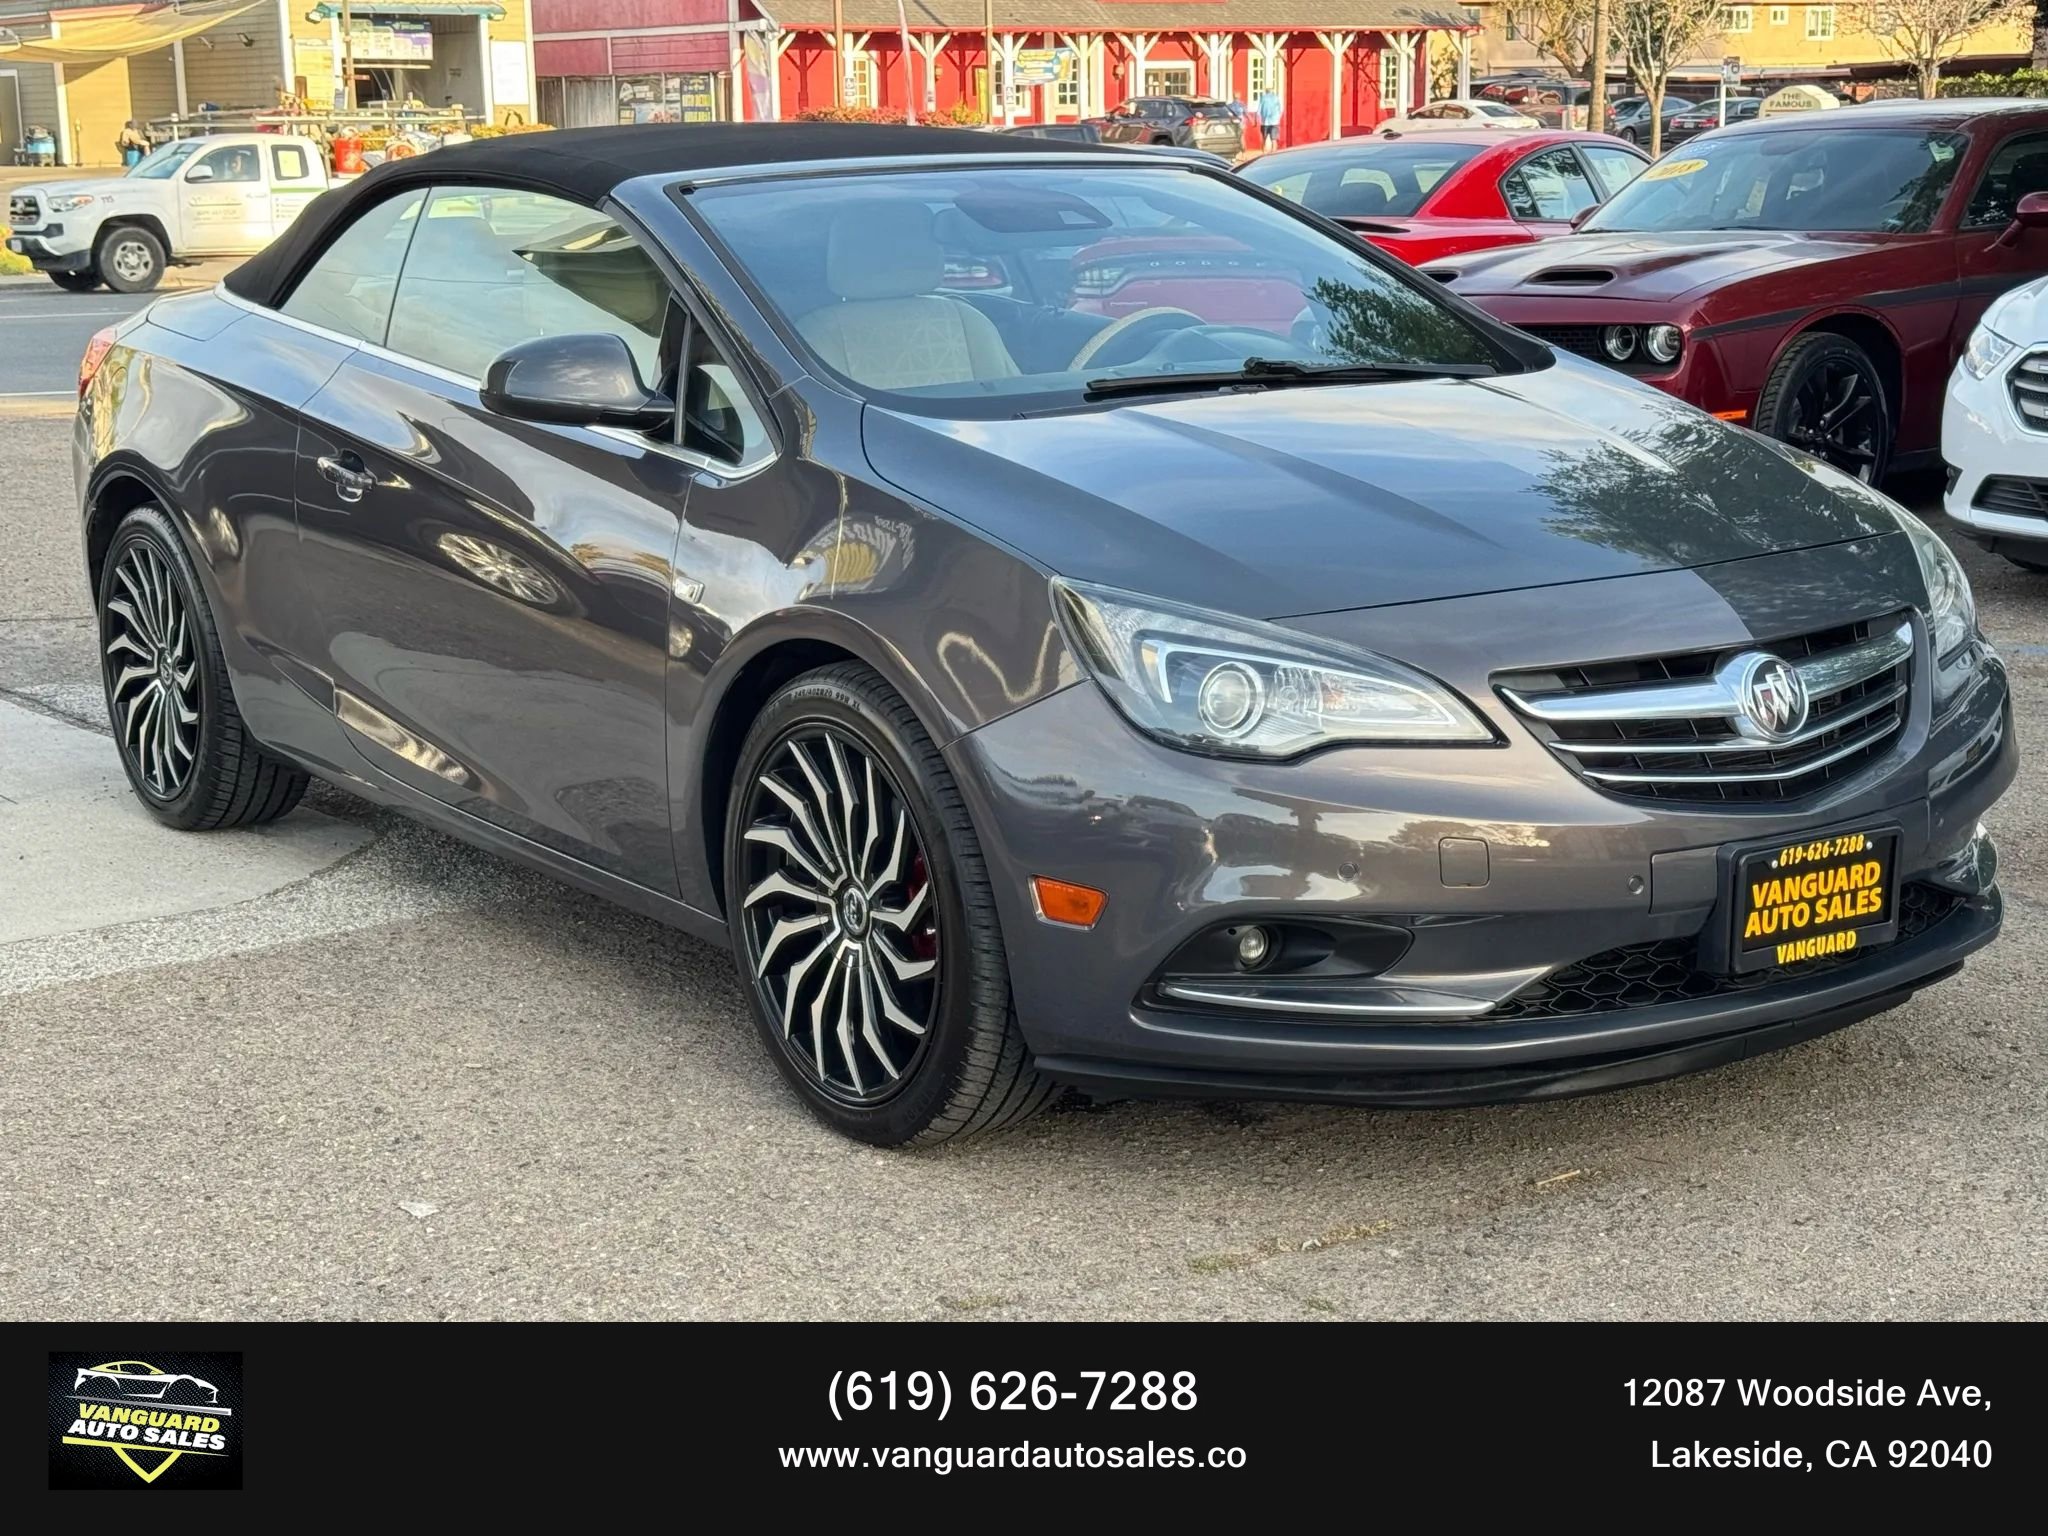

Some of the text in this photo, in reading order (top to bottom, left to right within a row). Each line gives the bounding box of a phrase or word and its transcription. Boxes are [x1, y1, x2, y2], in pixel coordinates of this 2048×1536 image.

[1780, 834, 1865, 867] 619-626-7288
[1752, 861, 1881, 909] VANGUARD
[1744, 887, 1882, 938] AUTO SALES
[1776, 930, 1857, 965] VANGUARD
